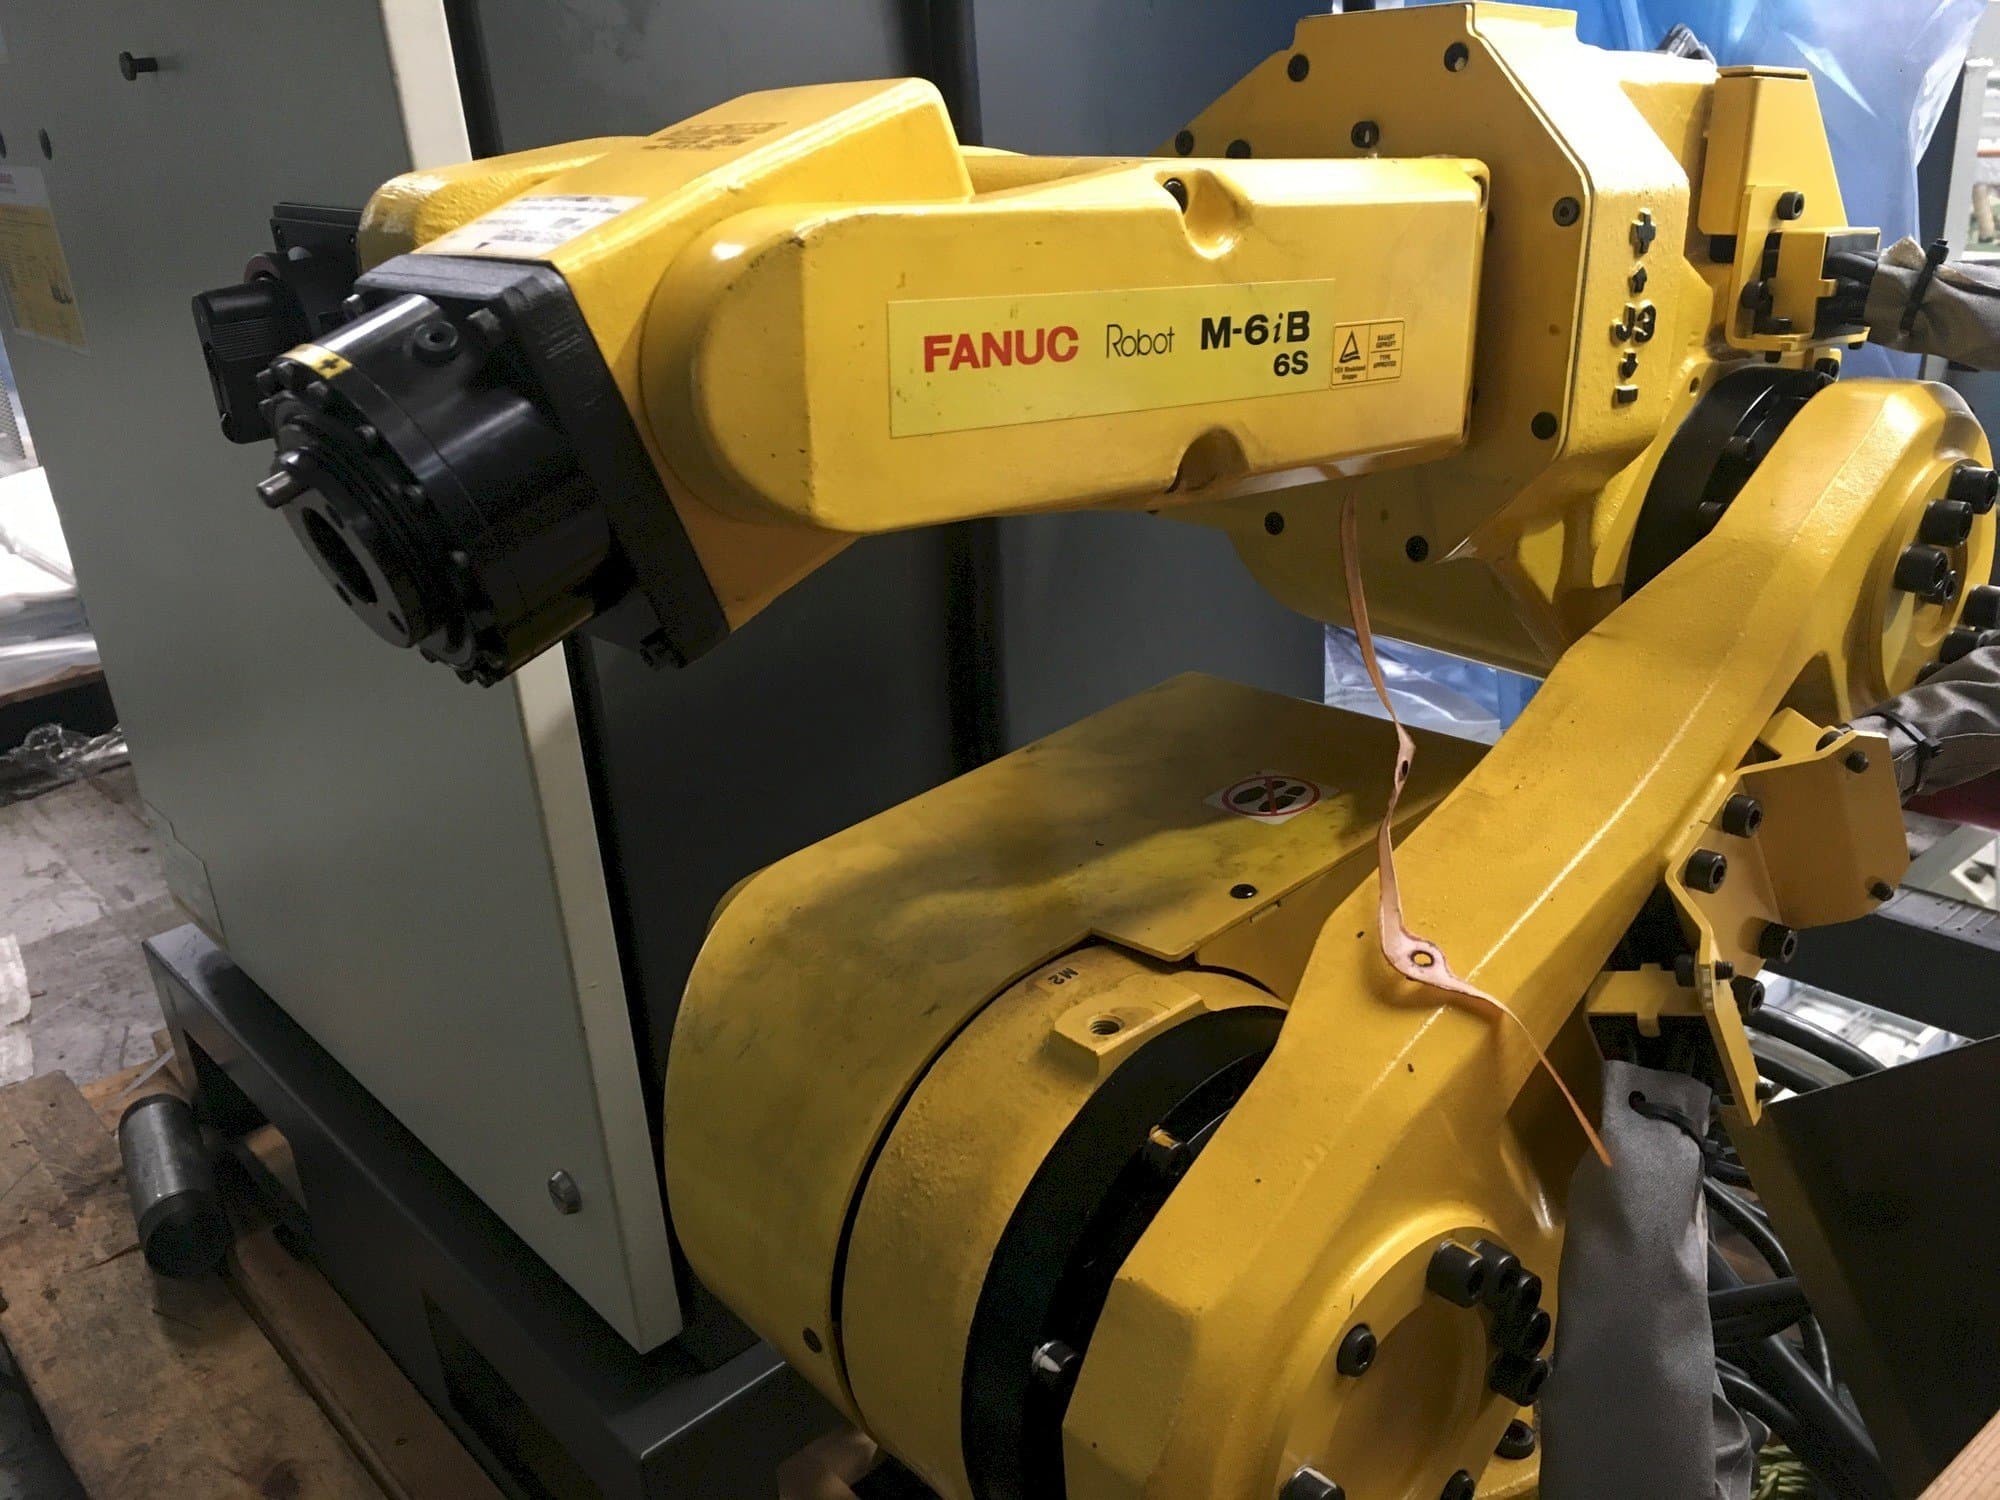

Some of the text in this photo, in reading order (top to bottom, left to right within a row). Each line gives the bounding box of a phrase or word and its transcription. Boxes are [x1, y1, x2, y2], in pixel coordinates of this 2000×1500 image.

[923, 310, 1310, 373] FANUC Robot M-6iB
[1273, 350, 1309, 377] 6S
[1048, 967, 1079, 985] M2
